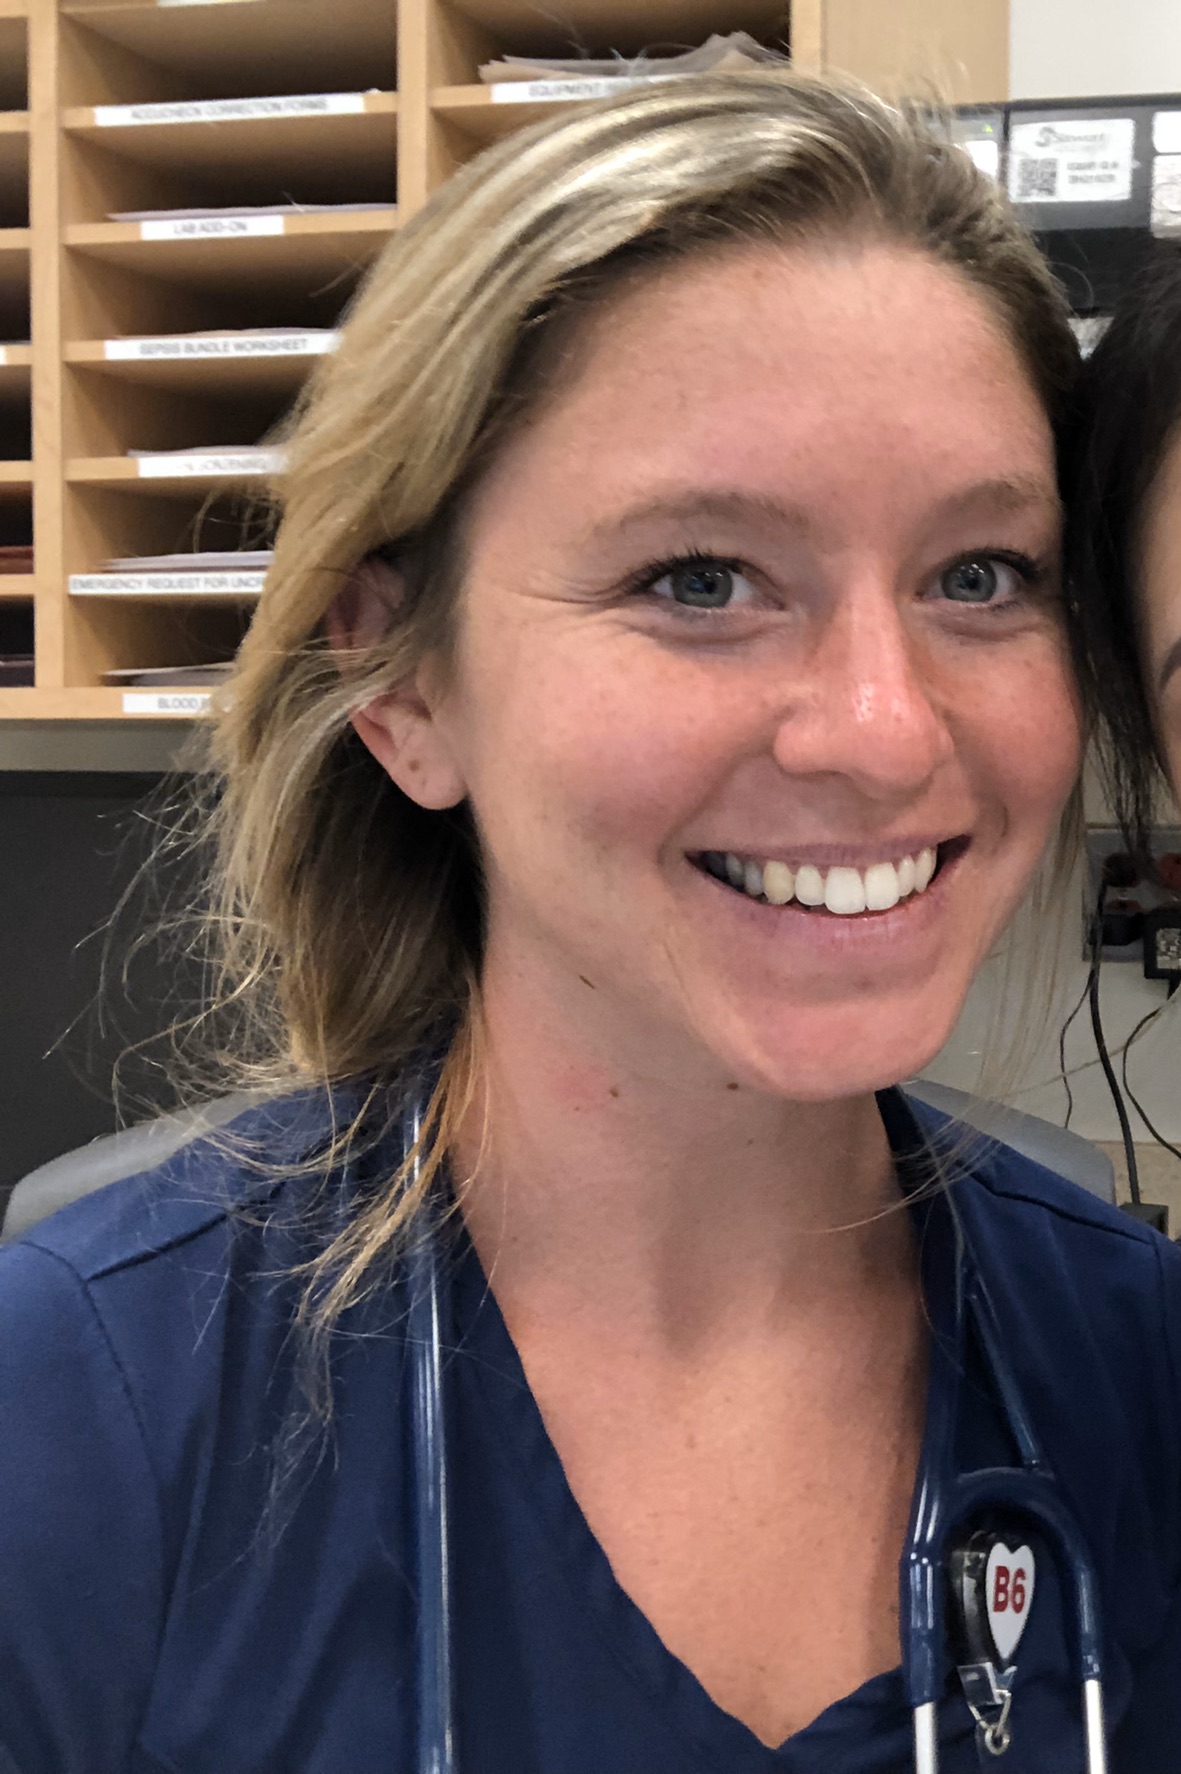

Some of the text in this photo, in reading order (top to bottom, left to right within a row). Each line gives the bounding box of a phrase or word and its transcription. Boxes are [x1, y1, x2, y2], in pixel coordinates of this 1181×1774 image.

[184, 341, 230, 354] BUNDLE
[233, 338, 307, 352] WORKSHEET
[71, 577, 142, 590] EMERGENCY
[147, 577, 200, 589] REQUEST
[204, 577, 228, 588] FOR
[158, 697, 198, 709] BLOOD
[993, 1565, 1026, 1614] B6
